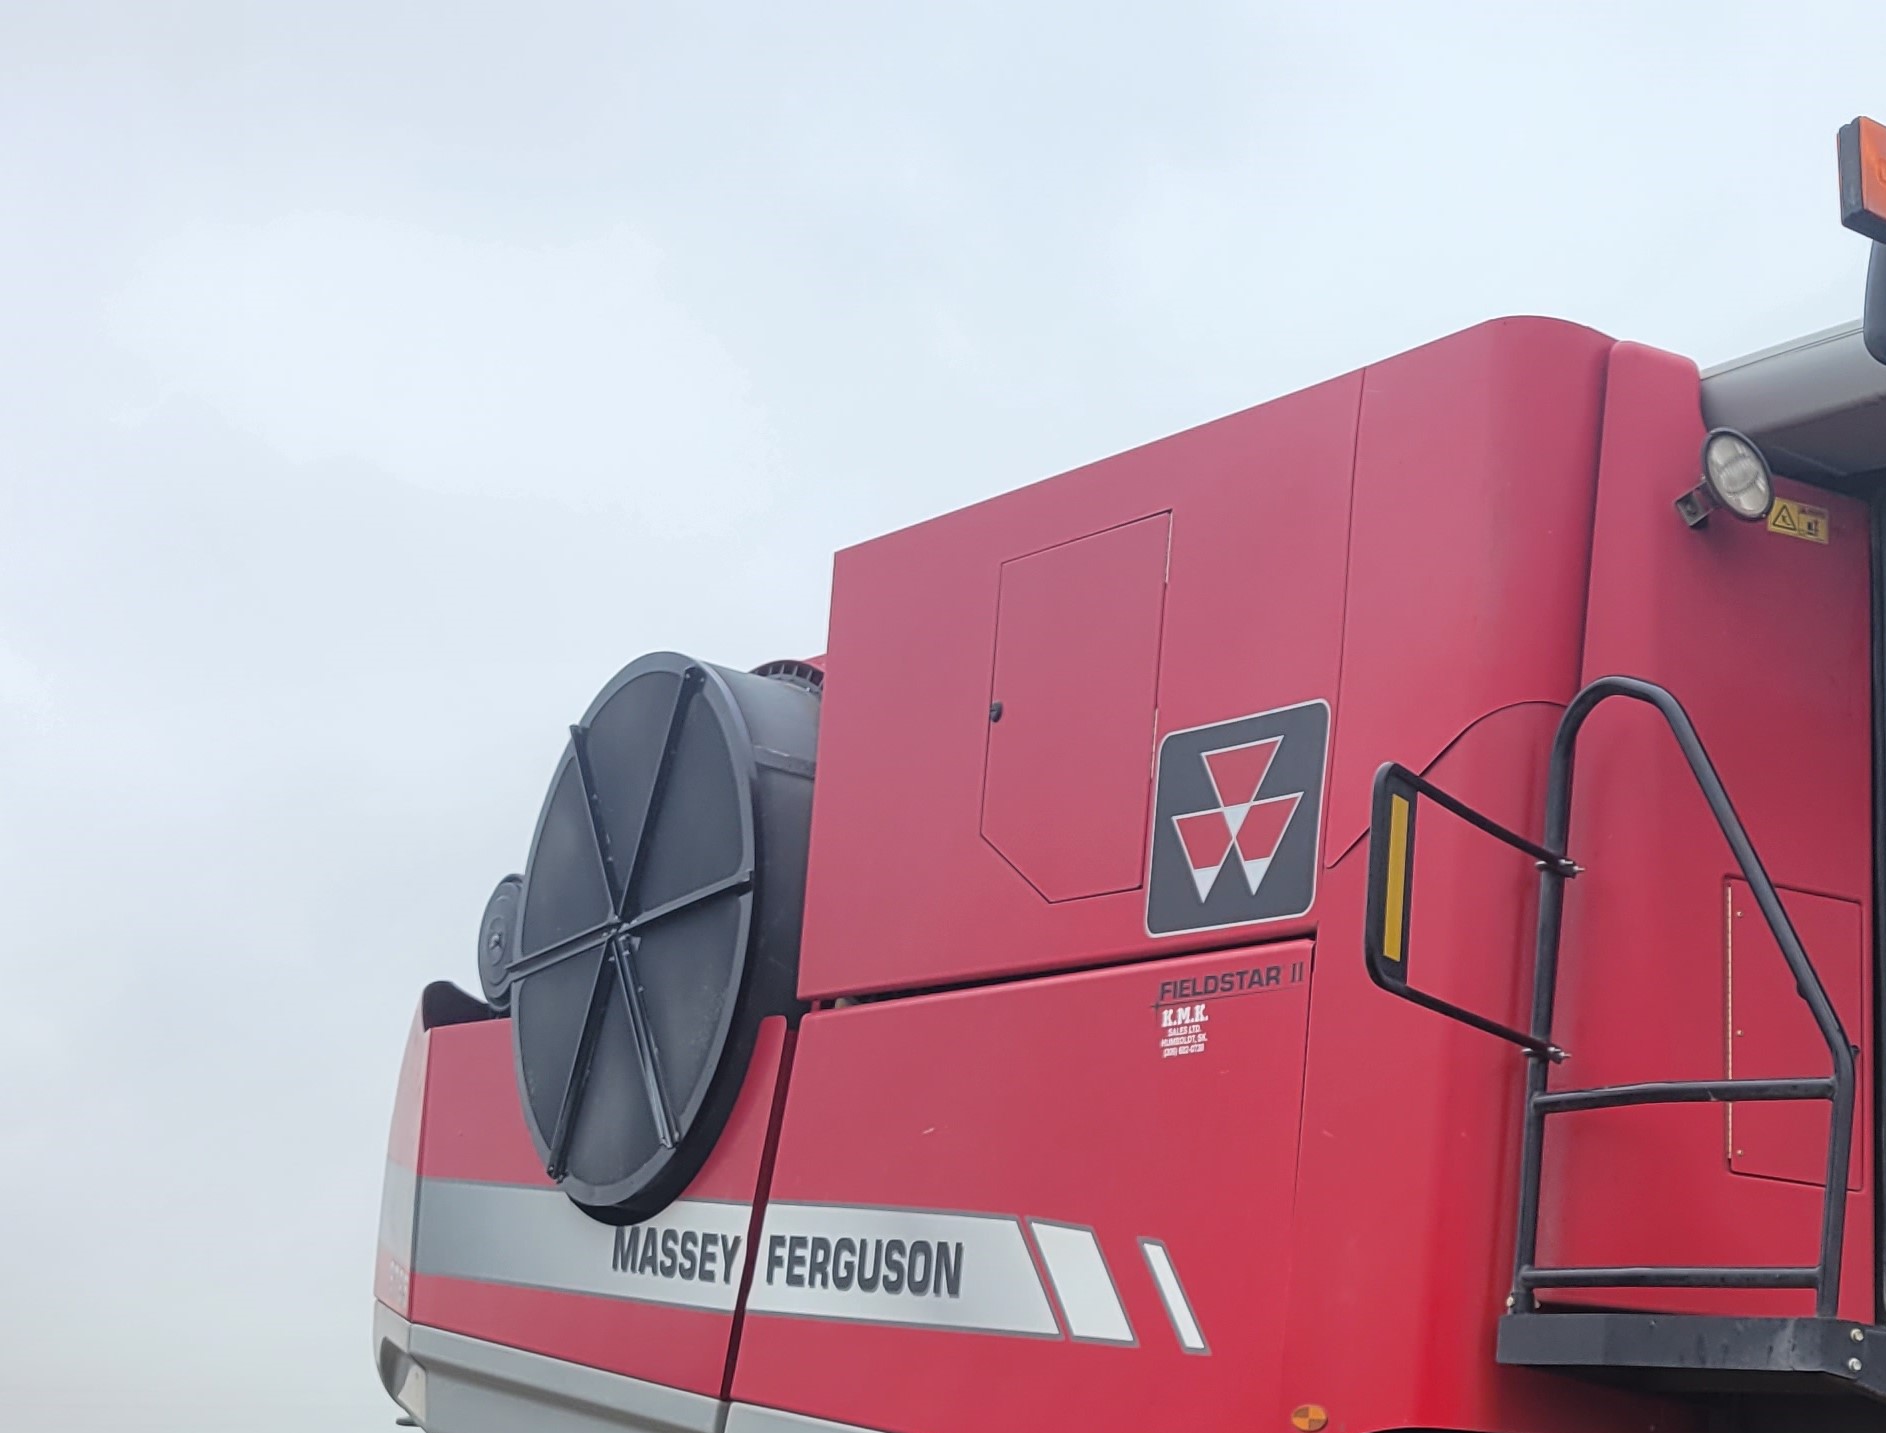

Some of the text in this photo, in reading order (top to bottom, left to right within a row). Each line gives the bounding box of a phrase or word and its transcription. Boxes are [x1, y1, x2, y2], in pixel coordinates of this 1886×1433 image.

[1160, 961, 1304, 1000] FIELDSTAR II
[1161, 1003, 1209, 1028] K.M.K.
[1168, 1026, 1188, 1037] SALES
[612, 1226, 964, 1299] MASSEY FERGUSON
